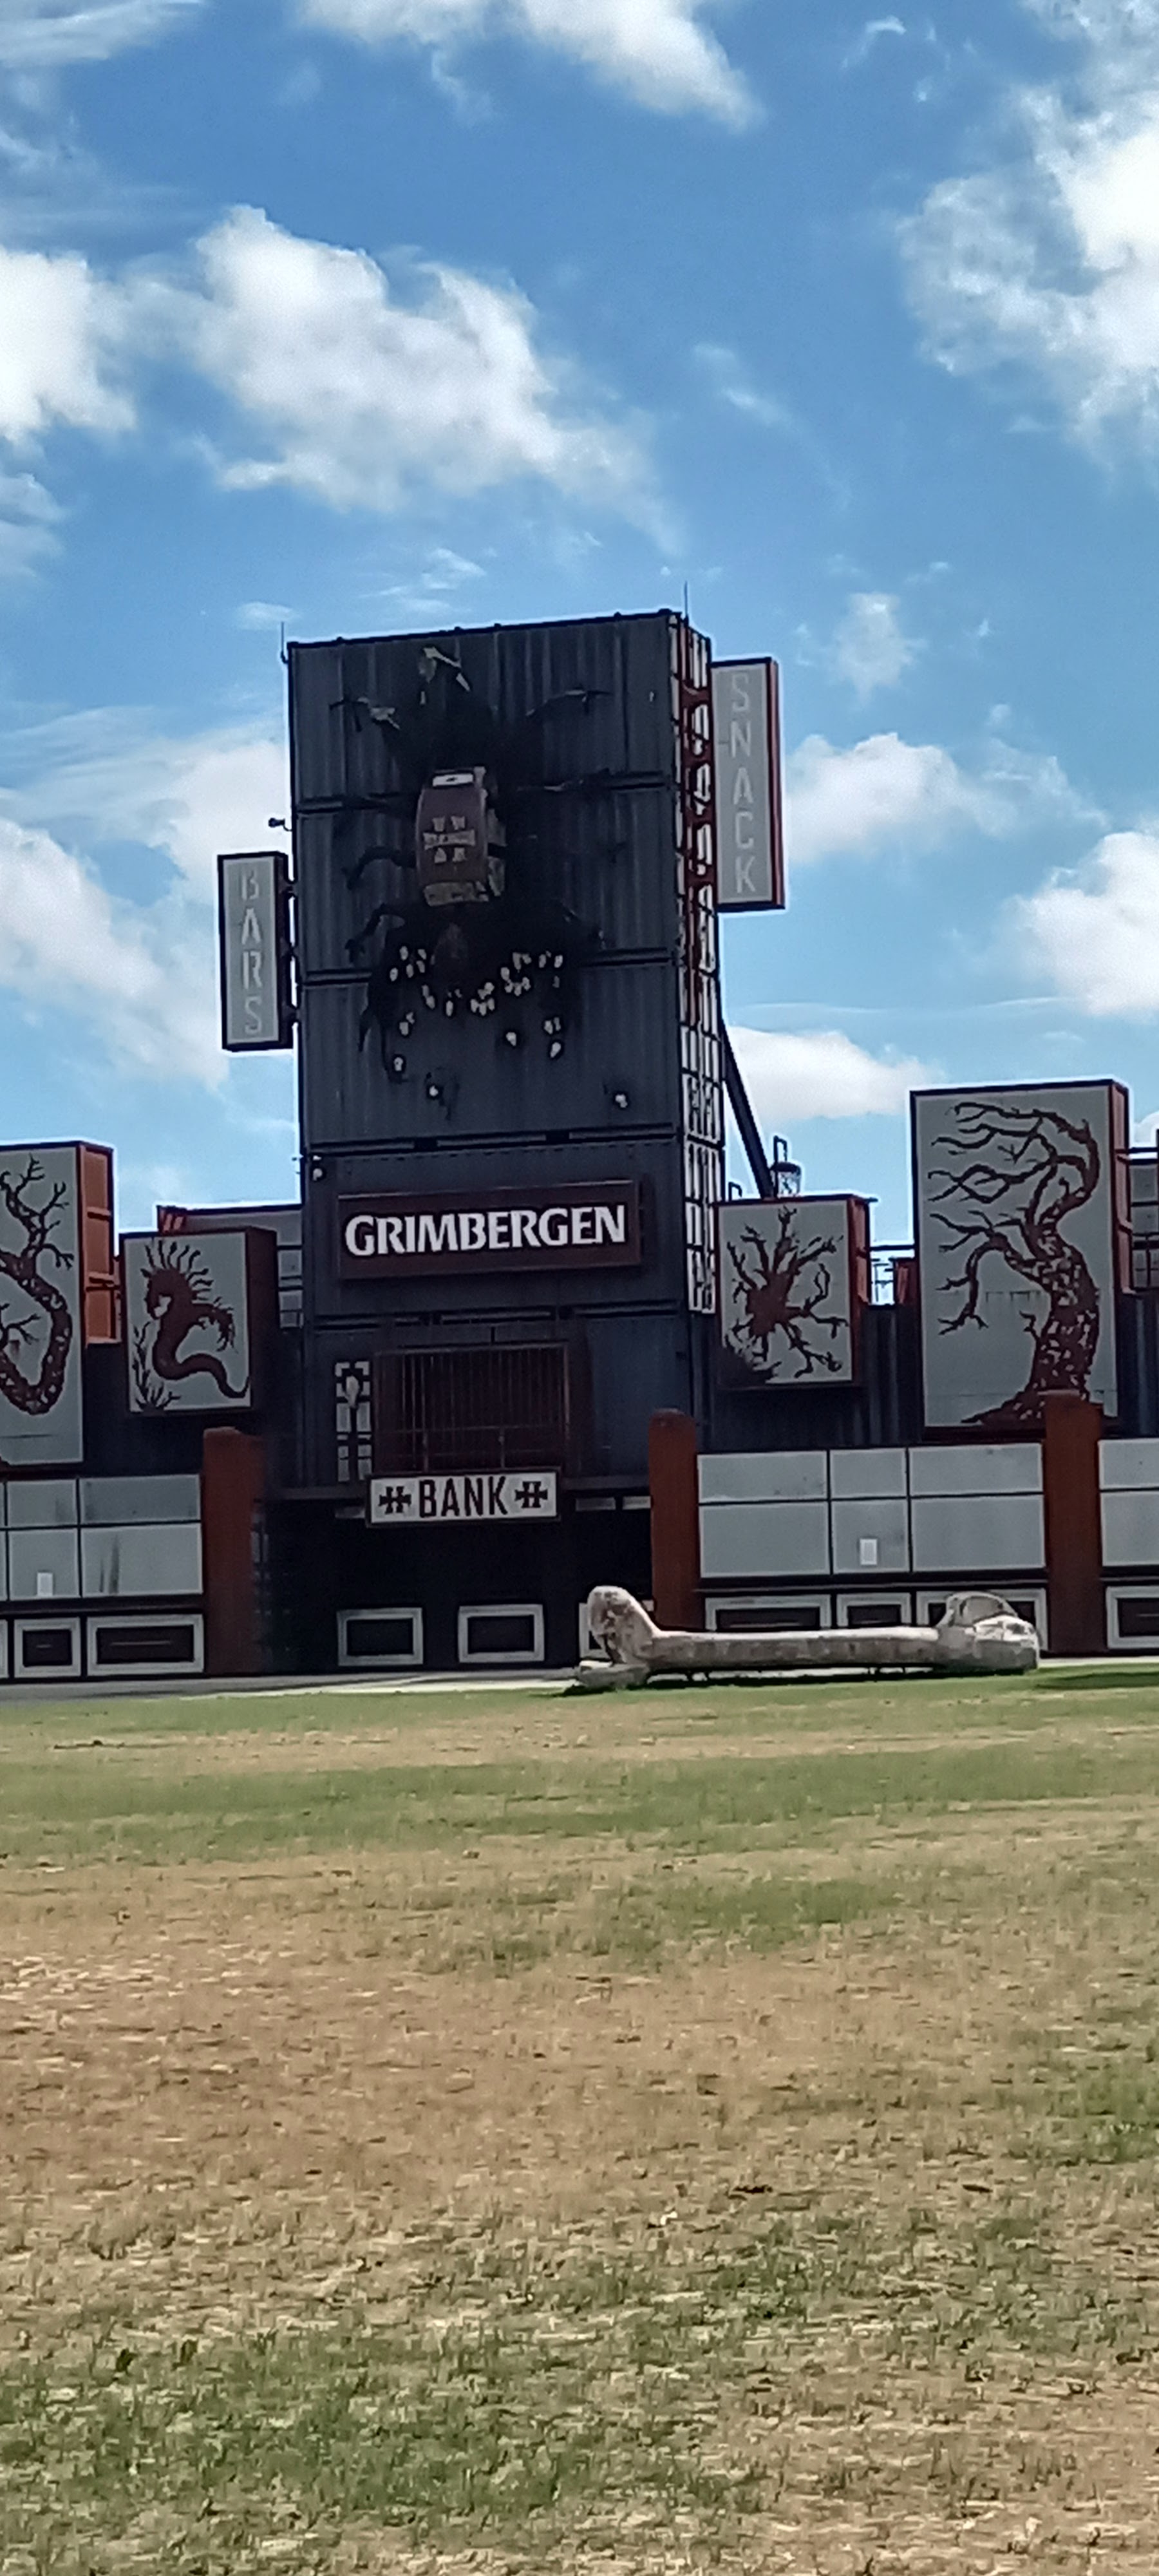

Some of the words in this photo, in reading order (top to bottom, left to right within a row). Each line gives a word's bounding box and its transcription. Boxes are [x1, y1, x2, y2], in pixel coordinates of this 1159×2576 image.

[730, 672, 756, 893] SNACK
[241, 869, 263, 1035] BARS
[344, 1205, 626, 1256] GRIMBERGEN
[419, 1475, 508, 1518] BANK
